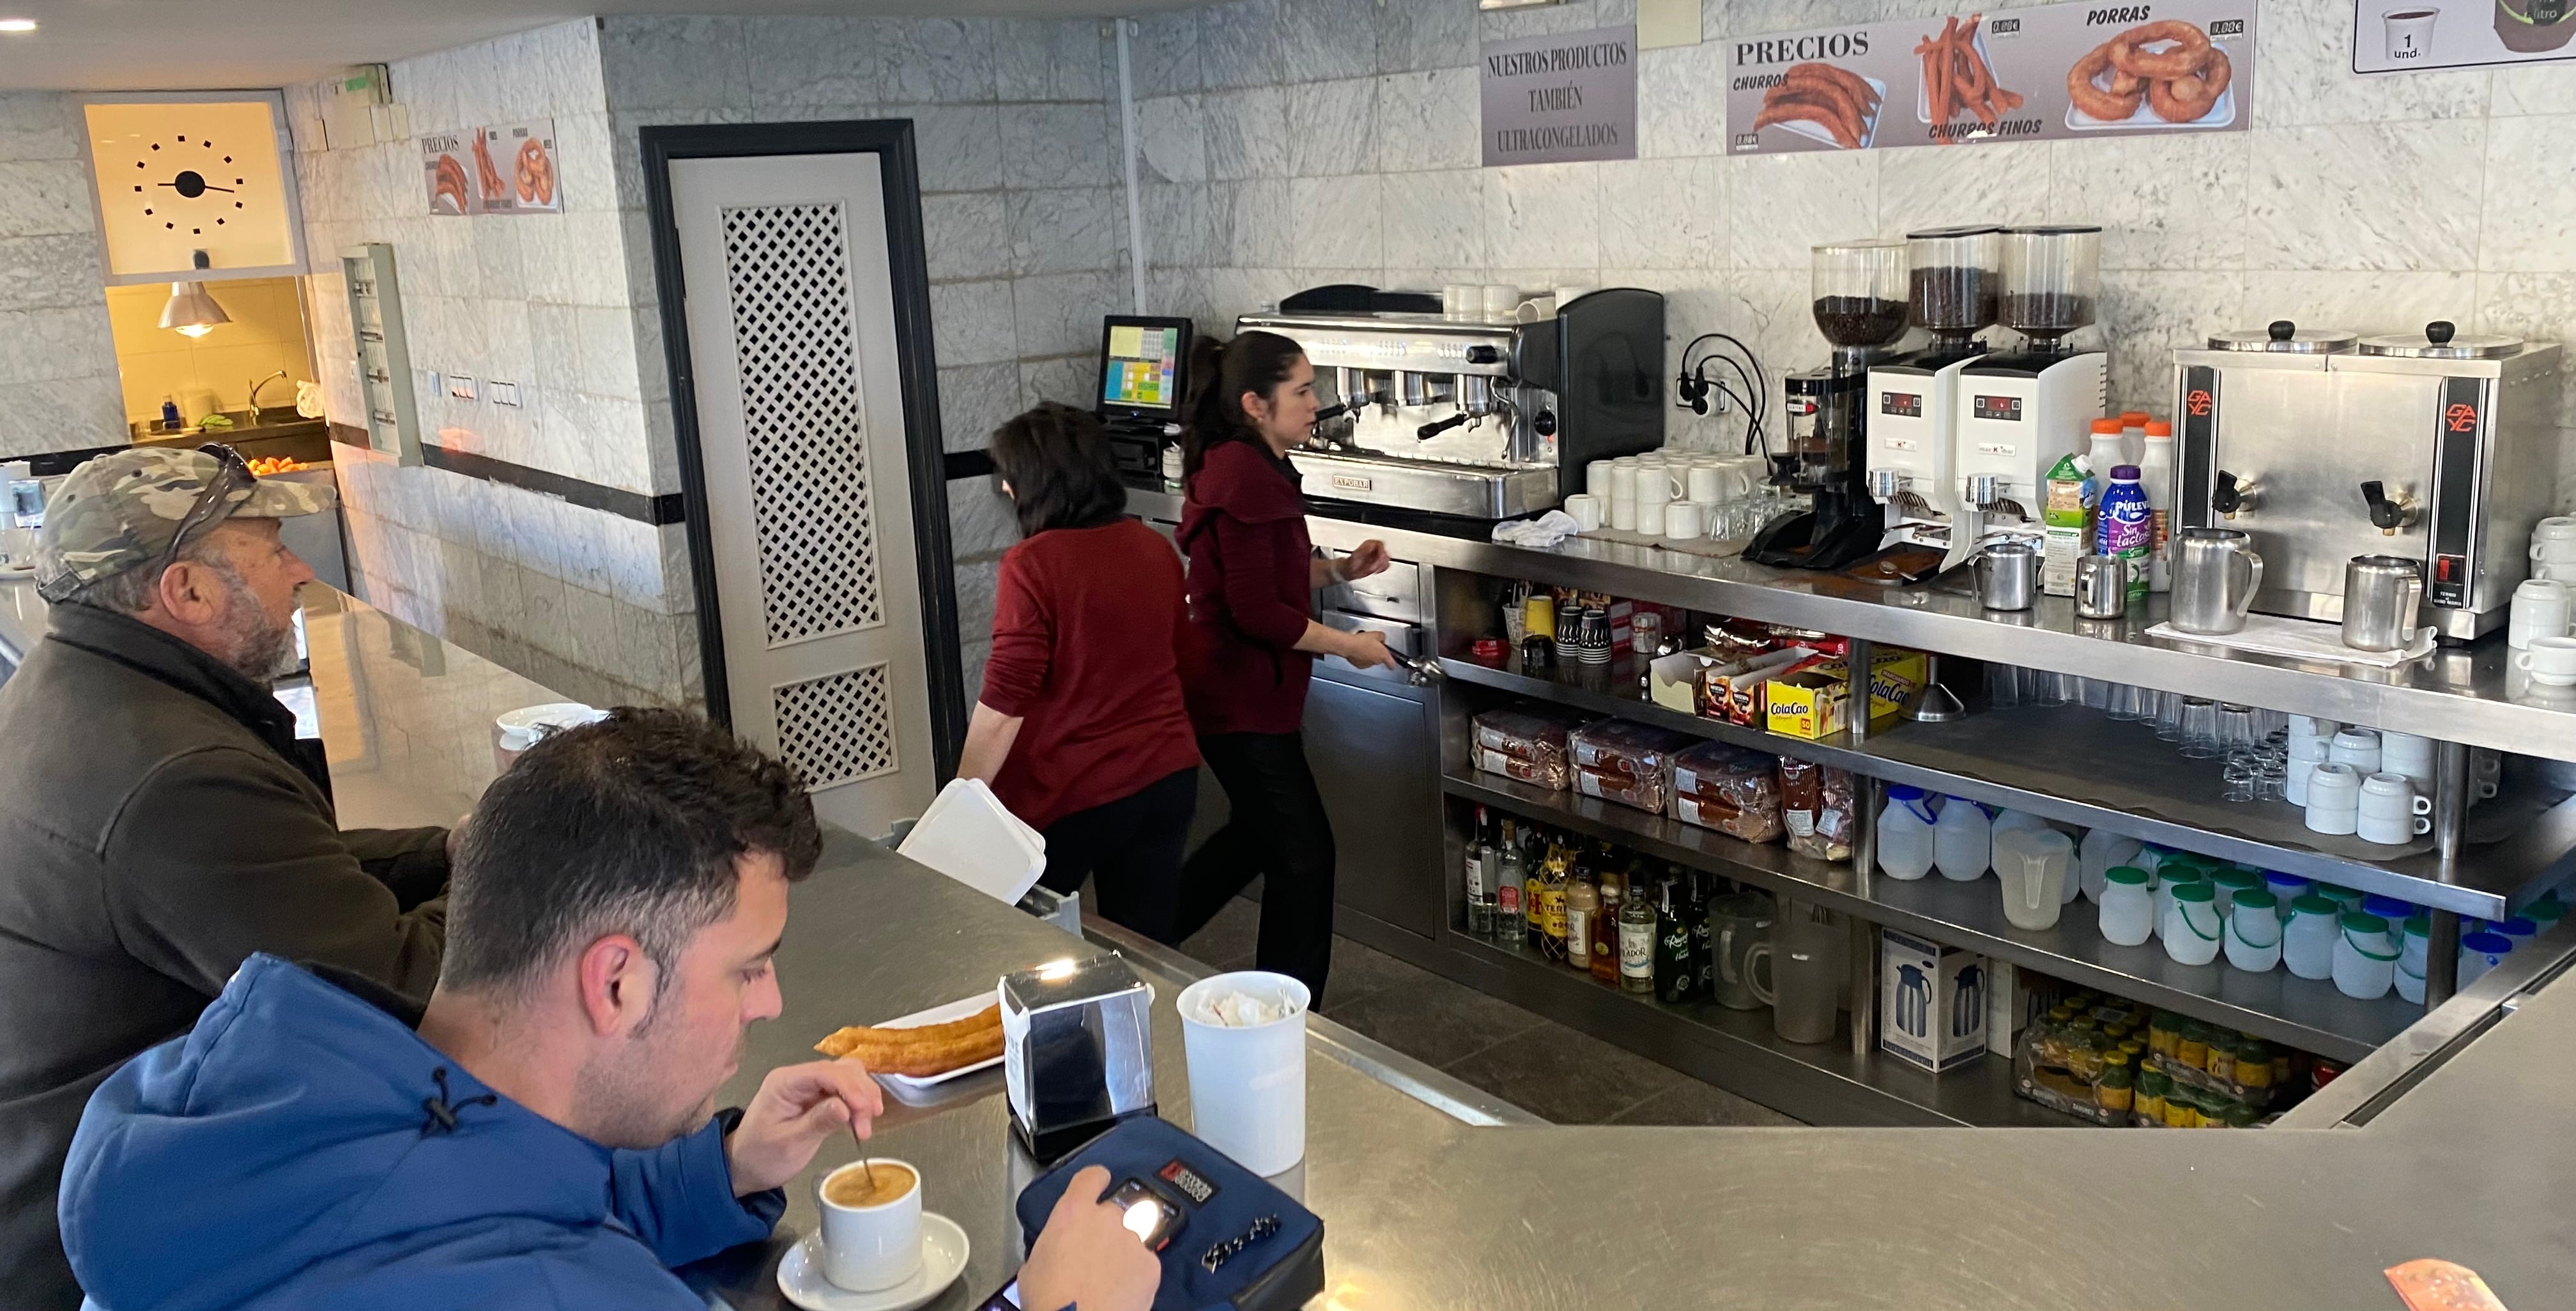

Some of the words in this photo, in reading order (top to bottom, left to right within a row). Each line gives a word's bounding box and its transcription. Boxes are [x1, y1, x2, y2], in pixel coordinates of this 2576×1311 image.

[2087, 6, 2150, 26] PORRAS
[1736, 31, 1869, 66] PRECIOS
[2404, 34, 2412, 48] 1
[1488, 50, 1549, 78] NUESTROS
[1551, 41, 1627, 72] PRODUCTOS
[2395, 48, 2421, 59] und.
[1733, 73, 1789, 91] CHURROS
[1528, 80, 1583, 112] TAMBIÉN
[1498, 123, 1618, 152] ULTRACONGELADOS
[1929, 122, 1995, 138] CHURROS
[1998, 119, 2043, 135] FINOS
[421, 135, 459, 154] PRECIOS
[2121, 525, 2138, 536] Sin
[1871, 675, 1910, 705] olaCao
[1771, 702, 1809, 715] ColaCao
[1802, 720, 1811, 729] 50
